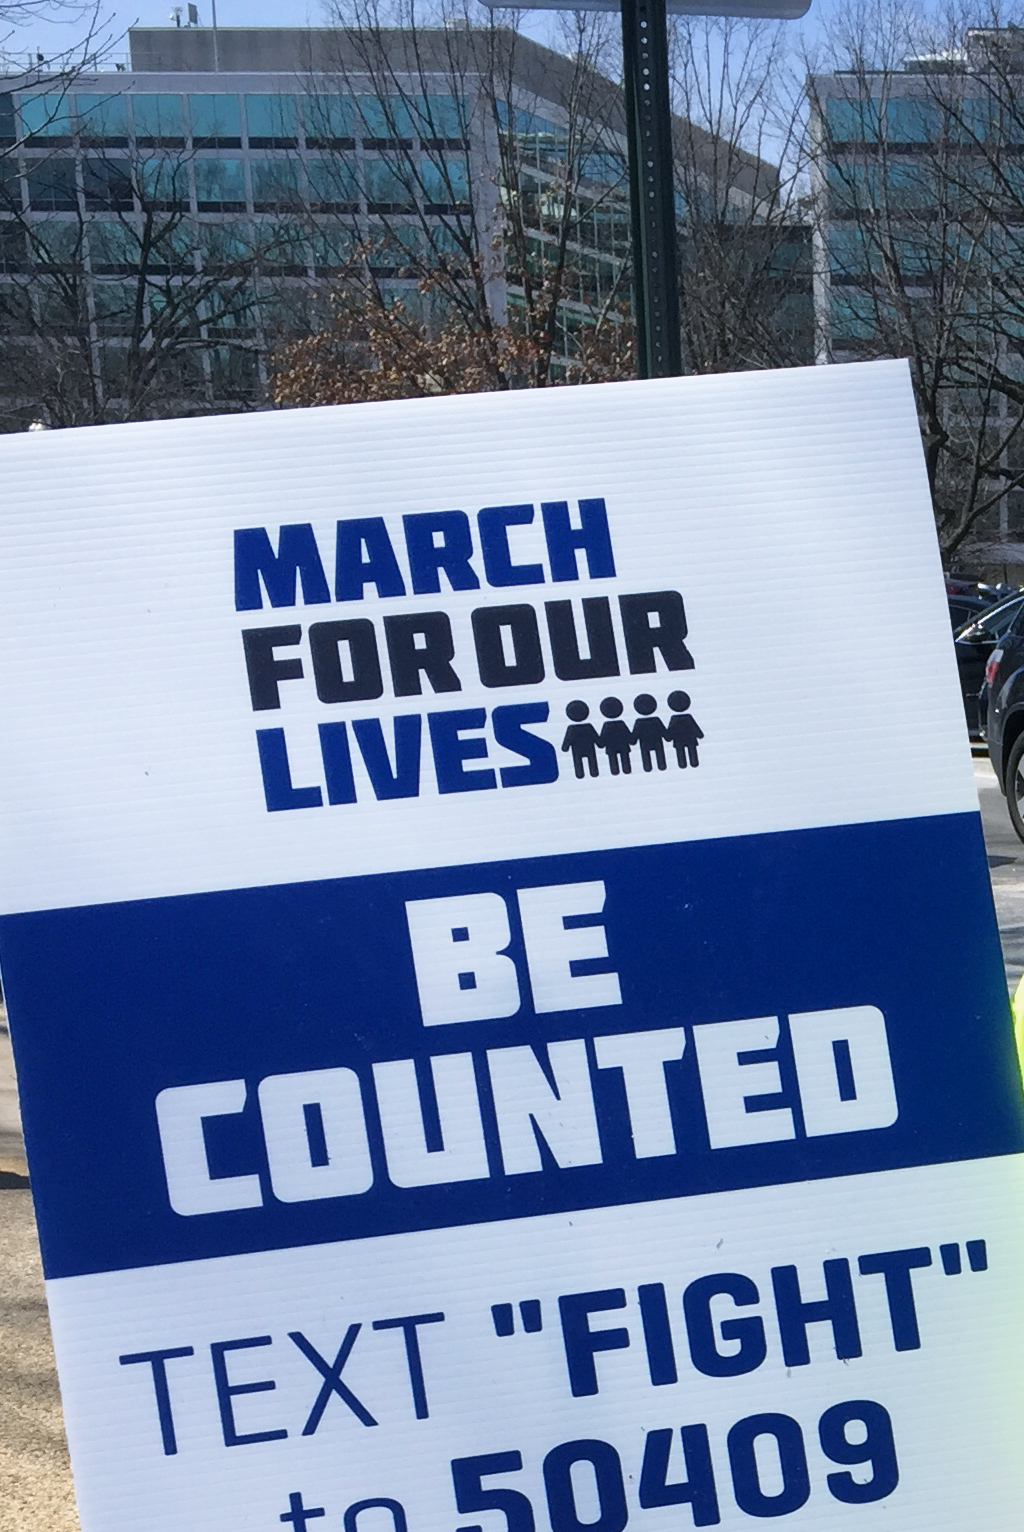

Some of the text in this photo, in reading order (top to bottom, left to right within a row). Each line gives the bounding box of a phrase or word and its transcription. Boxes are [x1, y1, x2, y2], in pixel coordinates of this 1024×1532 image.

[233, 497, 617, 611] MARCH
[241, 590, 695, 711] FOR OUR
[256, 701, 559, 812] LIVES
[405, 880, 623, 1027] BE
[155, 1005, 899, 1217] COUNTED
[118, 1311, 445, 1456] TEXT
[490, 1239, 989, 1398] "FIGHT"
